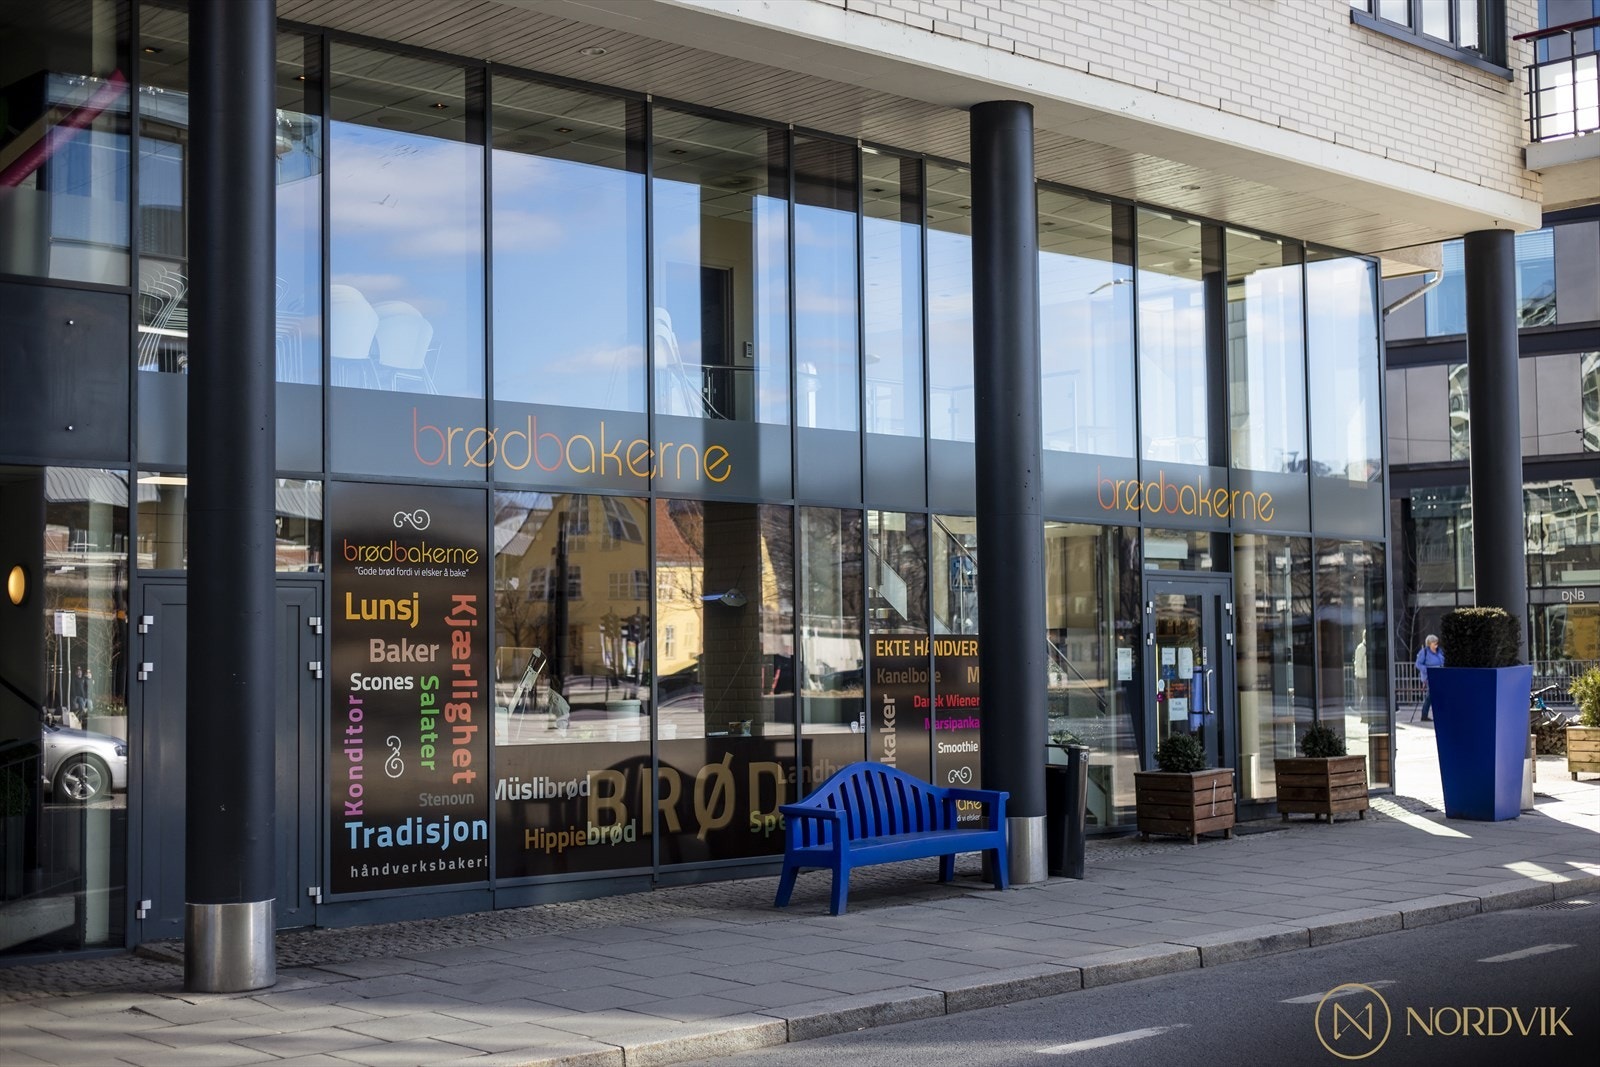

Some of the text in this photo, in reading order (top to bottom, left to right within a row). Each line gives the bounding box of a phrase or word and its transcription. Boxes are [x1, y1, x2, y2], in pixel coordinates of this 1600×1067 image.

[412, 406, 732, 483] brødbakerne
[1097, 464, 1274, 522] brødbakerne
[344, 538, 479, 565] brødbakerne
[378, 566, 395, 577] brød
[396, 566, 413, 576] fordi
[413, 567, 421, 577] vi
[421, 567, 442, 577] elsker
[443, 567, 449, 577] å
[345, 591, 420, 629] Lunsj
[1561, 587, 1586, 604] DNB
[369, 637, 440, 663] Baker
[875, 639, 911, 657] EKTE
[350, 672, 414, 691] Scones
[444, 594, 478, 785] Kjærlighet
[877, 667, 942, 684] Kanelbole
[420, 675, 440, 771] Salater
[879, 693, 897, 768] kaker
[344, 695, 364, 816] Konditor
[937, 740, 979, 755] Smoothie
[419, 792, 475, 807] Stenovn
[587, 751, 788, 843] BRØD
[344, 815, 488, 851] Tradisjon
[525, 818, 637, 855] Hippiebrød
[350, 855, 488, 879] håndverksbakeri
